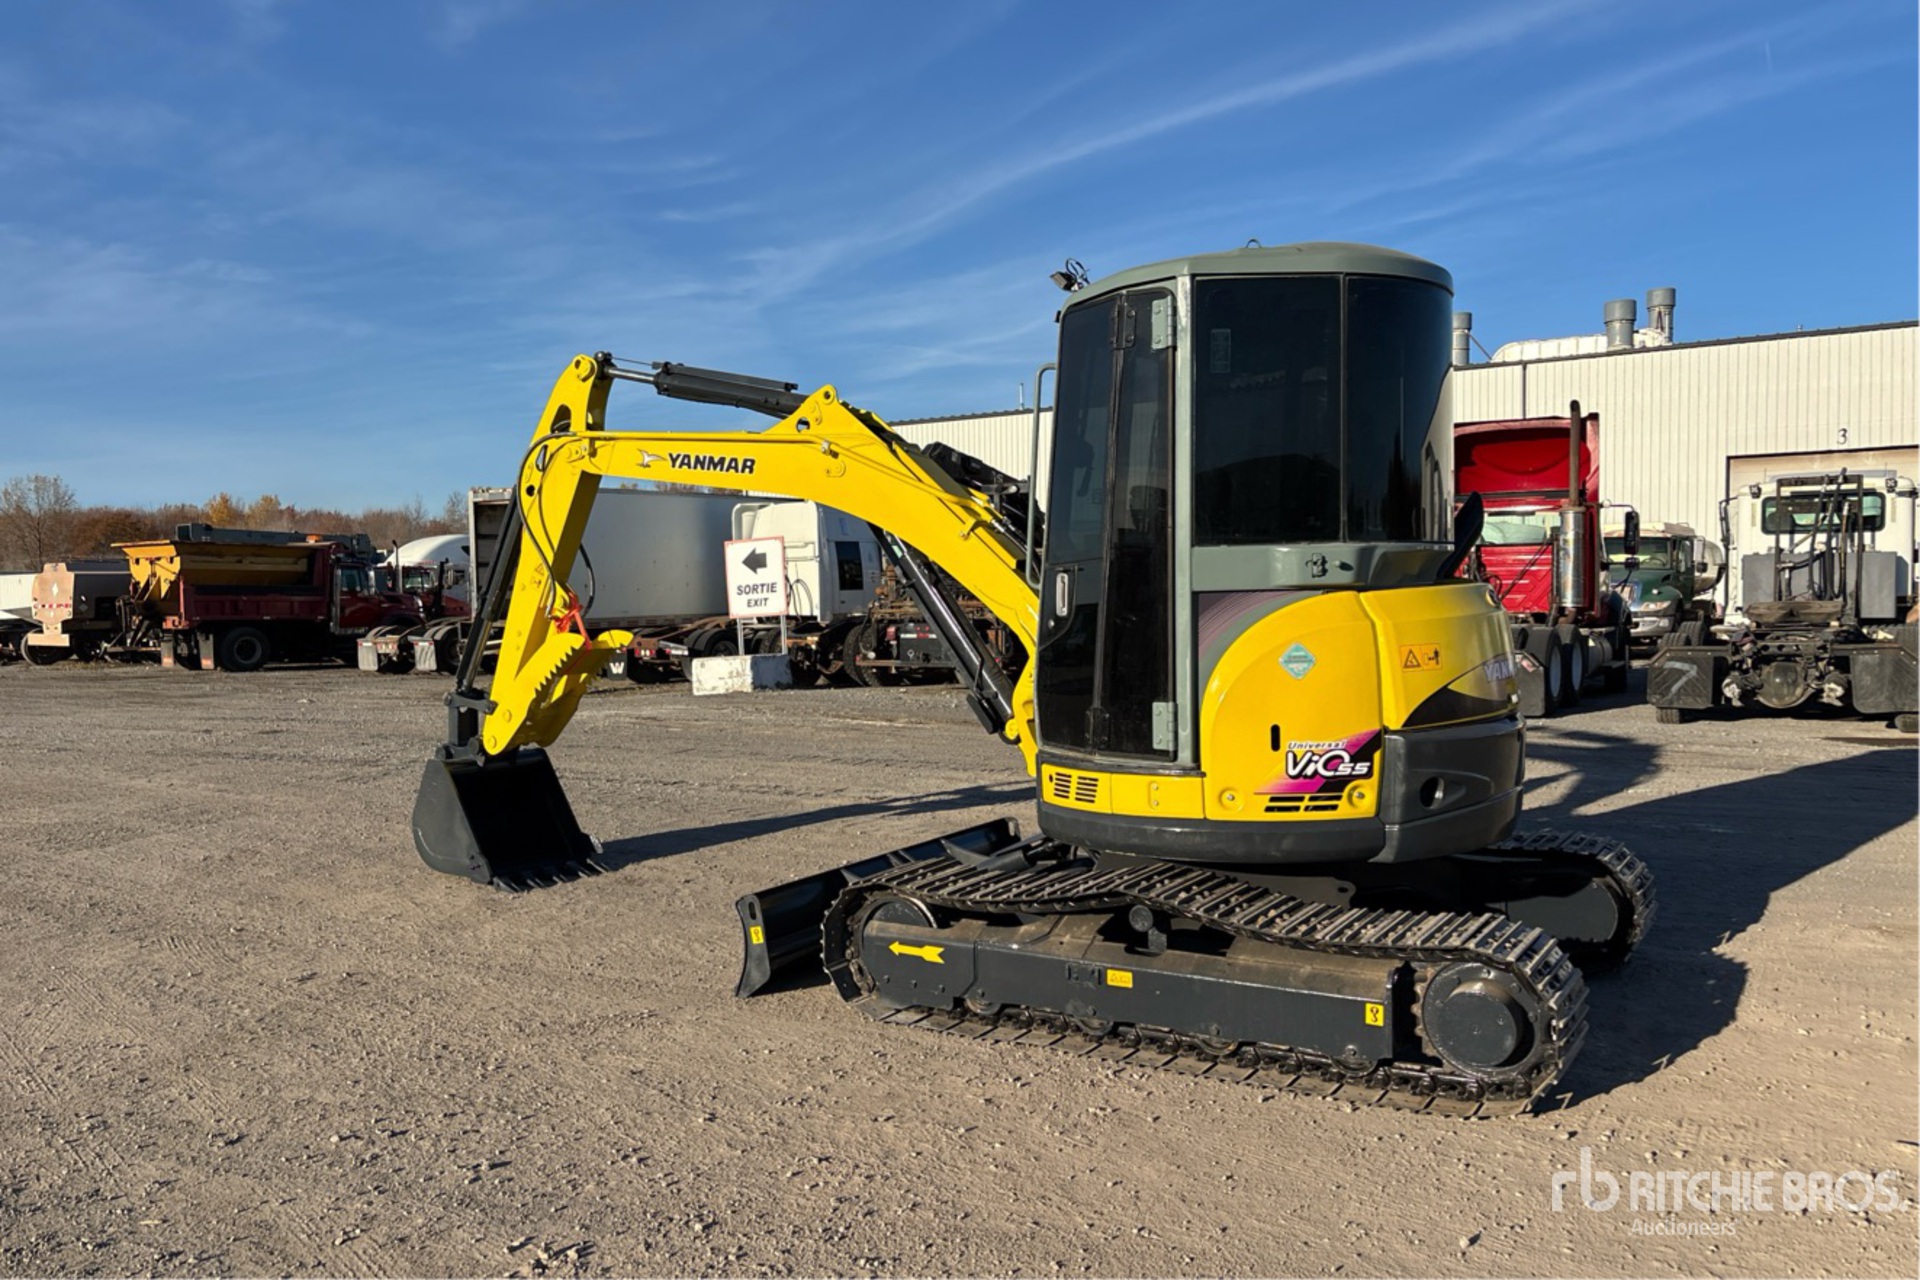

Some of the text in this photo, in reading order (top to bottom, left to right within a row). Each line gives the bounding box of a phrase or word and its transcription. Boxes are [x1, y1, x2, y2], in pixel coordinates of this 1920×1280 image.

[1837, 427, 1848, 445] 3
[668, 452, 756, 475] YANMAR
[736, 581, 778, 596] SORTIE
[746, 597, 769, 608] EXIT
[1288, 741, 1347, 750] Universal
